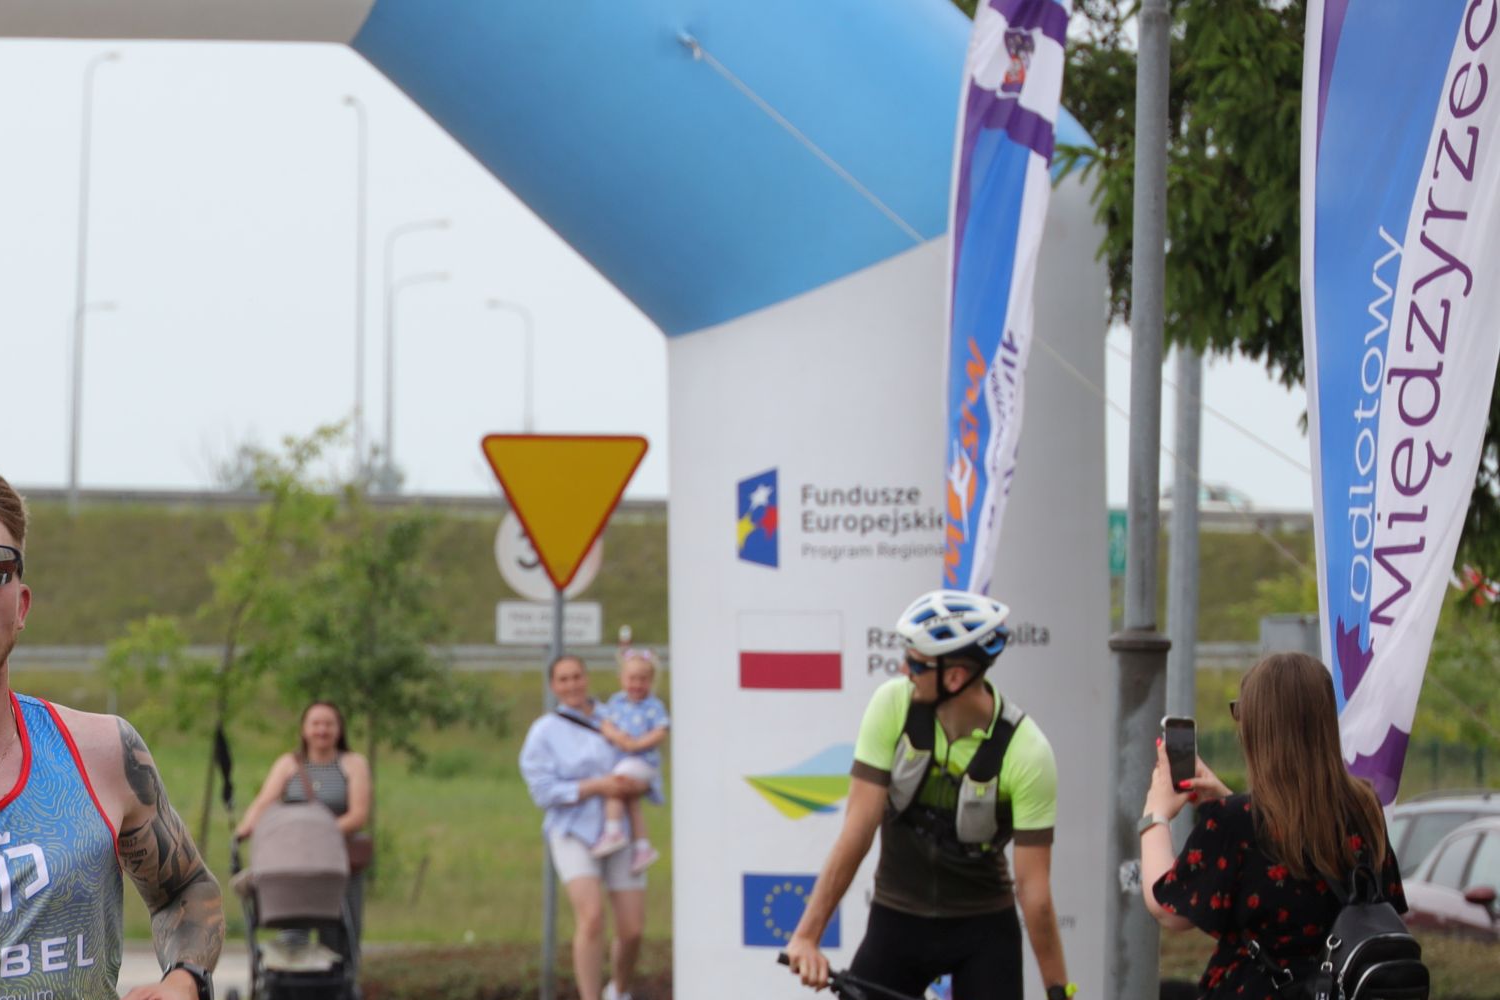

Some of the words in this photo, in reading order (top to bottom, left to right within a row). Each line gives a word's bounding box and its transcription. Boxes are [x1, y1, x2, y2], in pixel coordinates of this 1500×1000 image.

[1350, 225, 1405, 604] odlotowy
[801, 484, 921, 507] Fundusze
[801, 542, 874, 563] Program
